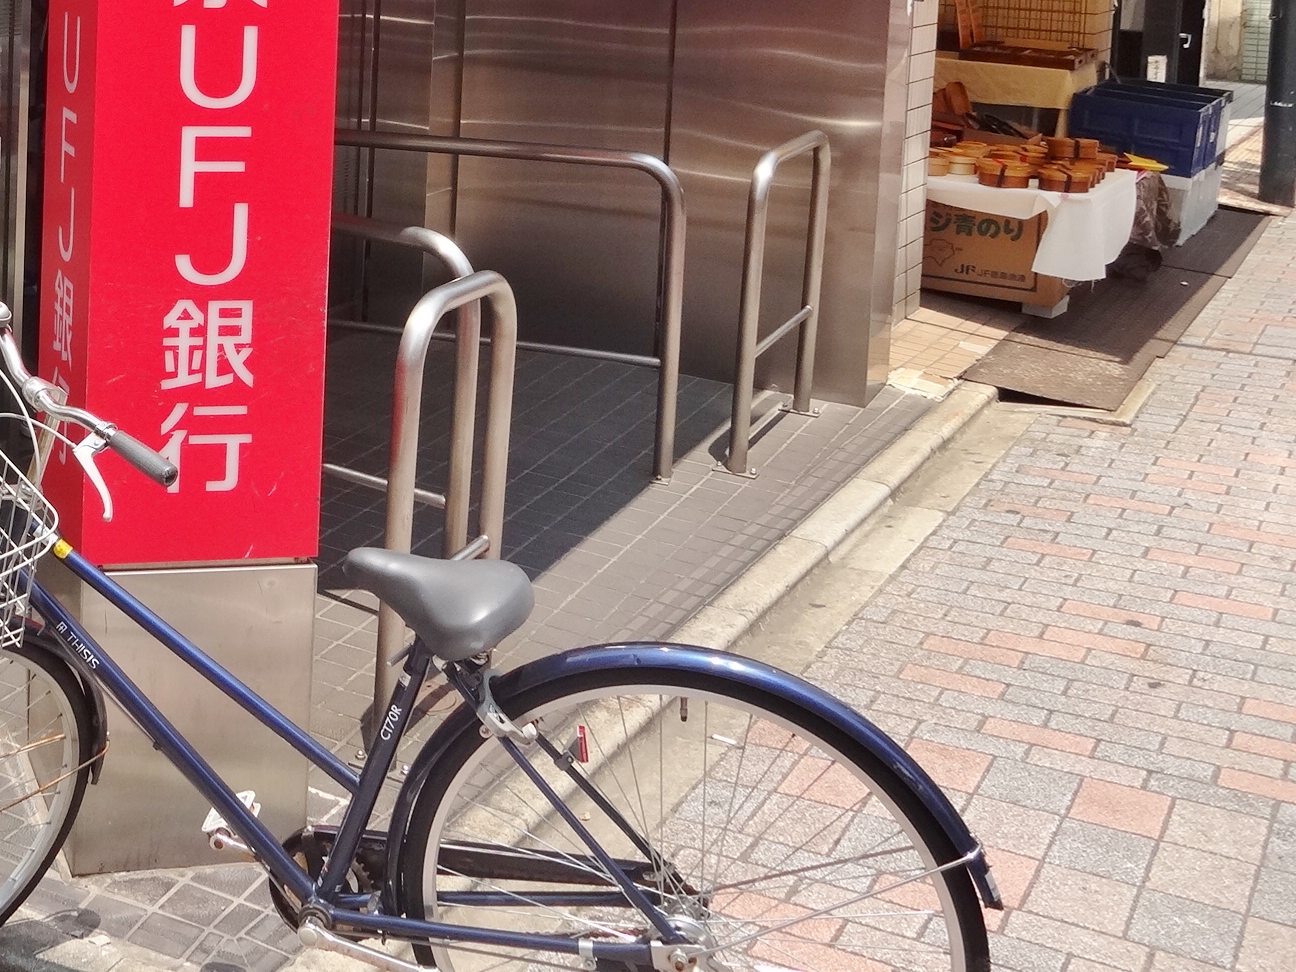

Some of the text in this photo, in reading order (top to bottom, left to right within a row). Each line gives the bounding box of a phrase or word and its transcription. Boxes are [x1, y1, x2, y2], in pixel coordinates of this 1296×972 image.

[930, 211, 1024, 242] ジ青のり
[380, 704, 402, 741] CT70R
